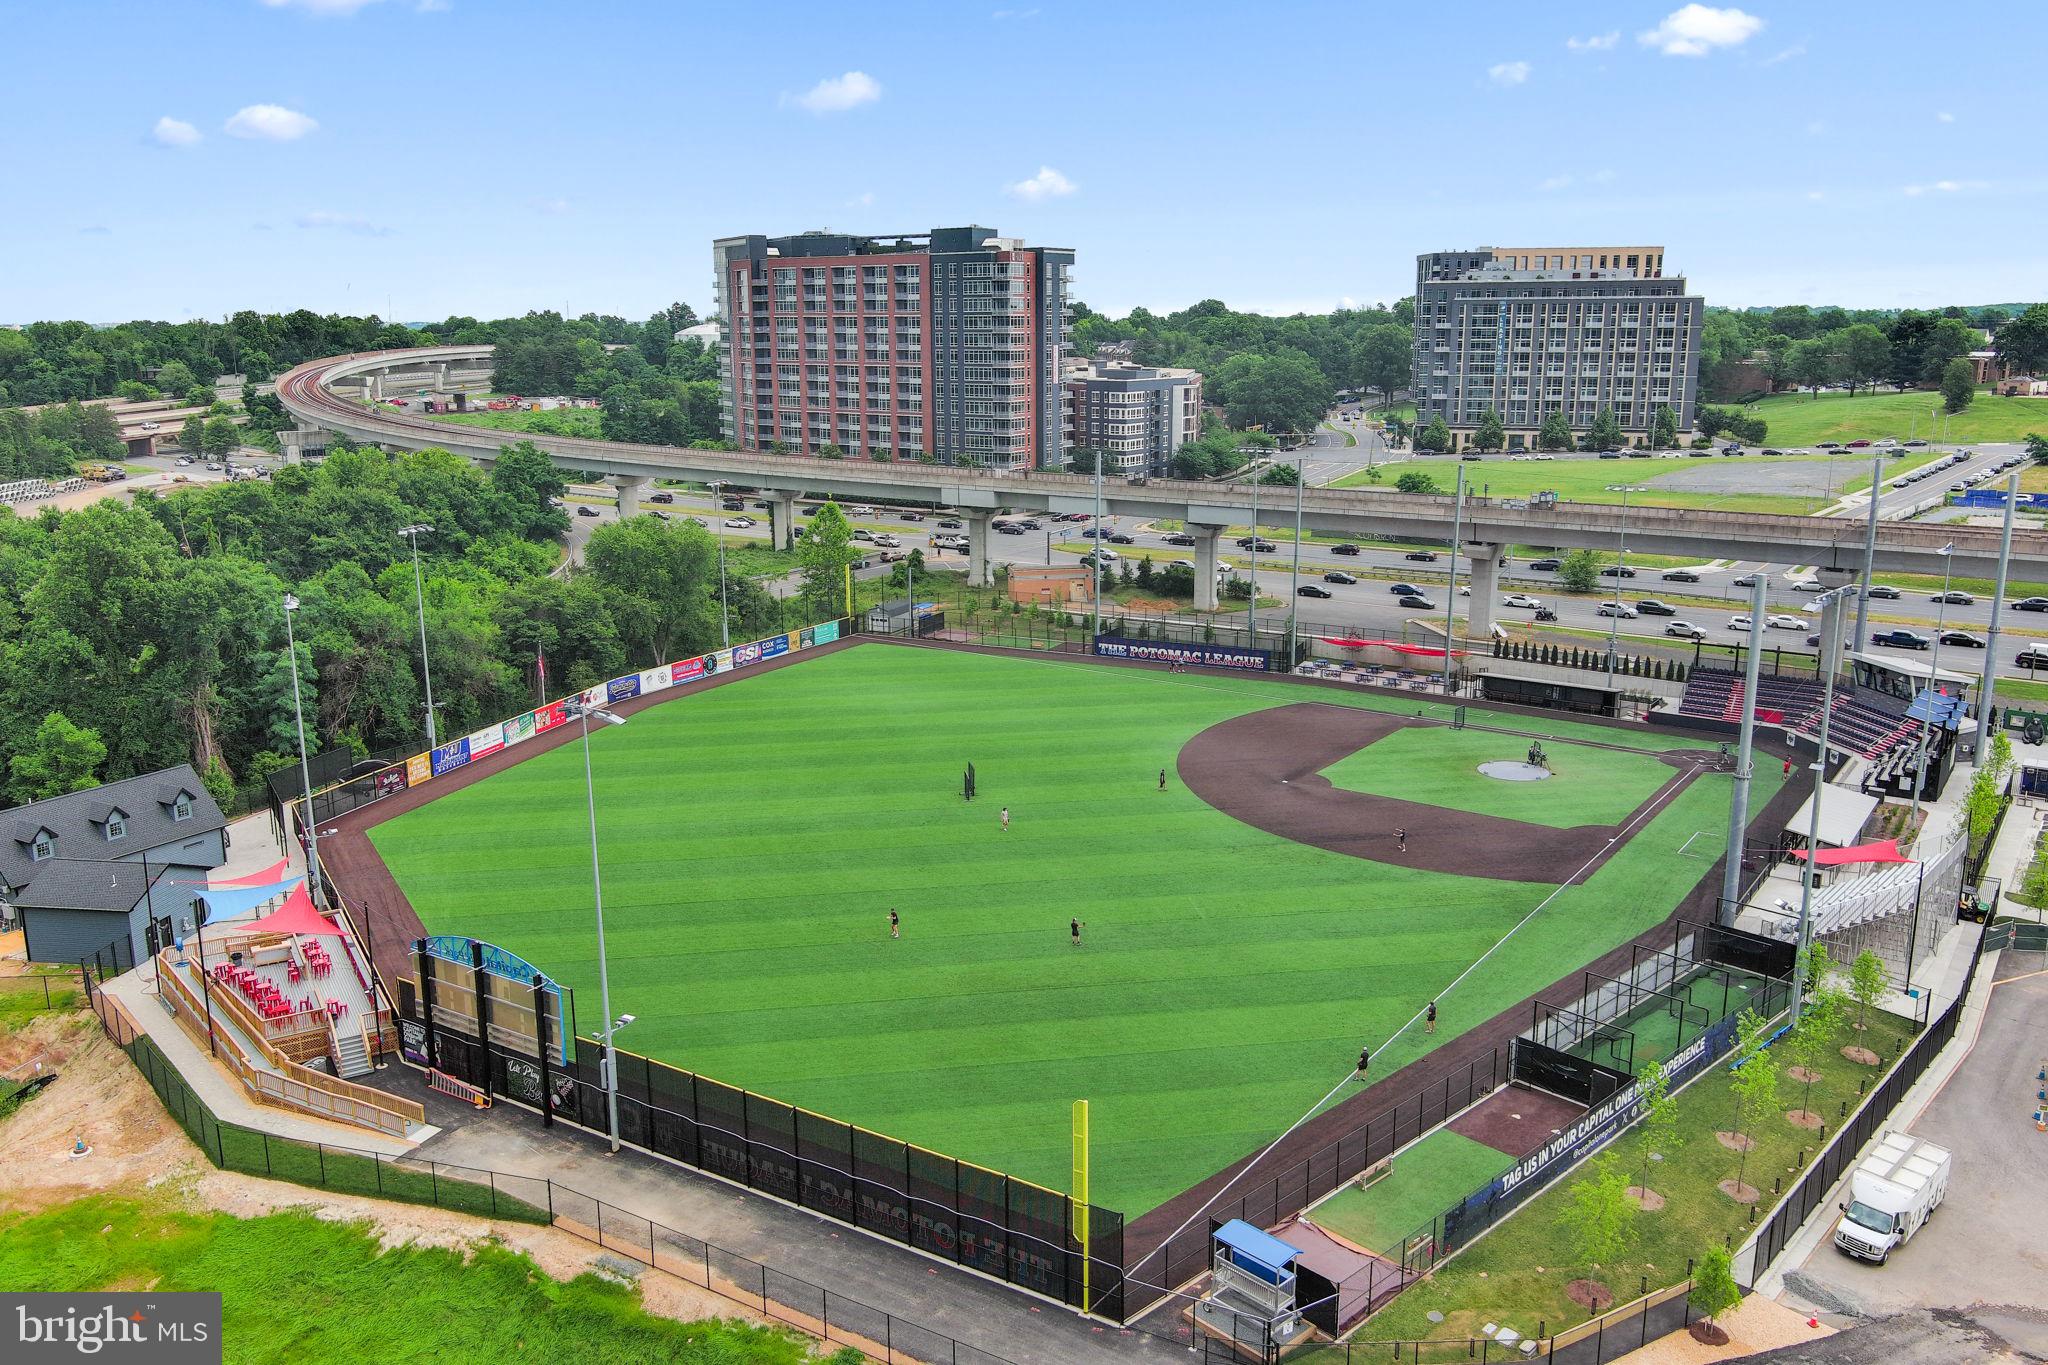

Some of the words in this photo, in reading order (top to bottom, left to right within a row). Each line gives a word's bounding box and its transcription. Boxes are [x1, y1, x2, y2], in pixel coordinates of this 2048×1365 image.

[735, 645, 760, 663] CSI
[762, 640, 775, 650] COX
[1098, 643, 1127, 657] THE
[1130, 645, 1202, 664] POTOMAC
[1204, 652, 1265, 669] LEAGUE
[1502, 1166, 1522, 1191] TAG
[1523, 1155, 1538, 1176] US
[1538, 1148, 1549, 1167] IN
[1550, 1128, 1578, 1158] YOUR
[1578, 1101, 1615, 1138] CAPITAL
[1615, 1086, 1634, 1110] ONE
[1572, 1119, 1618, 1159] @capitalonepark
